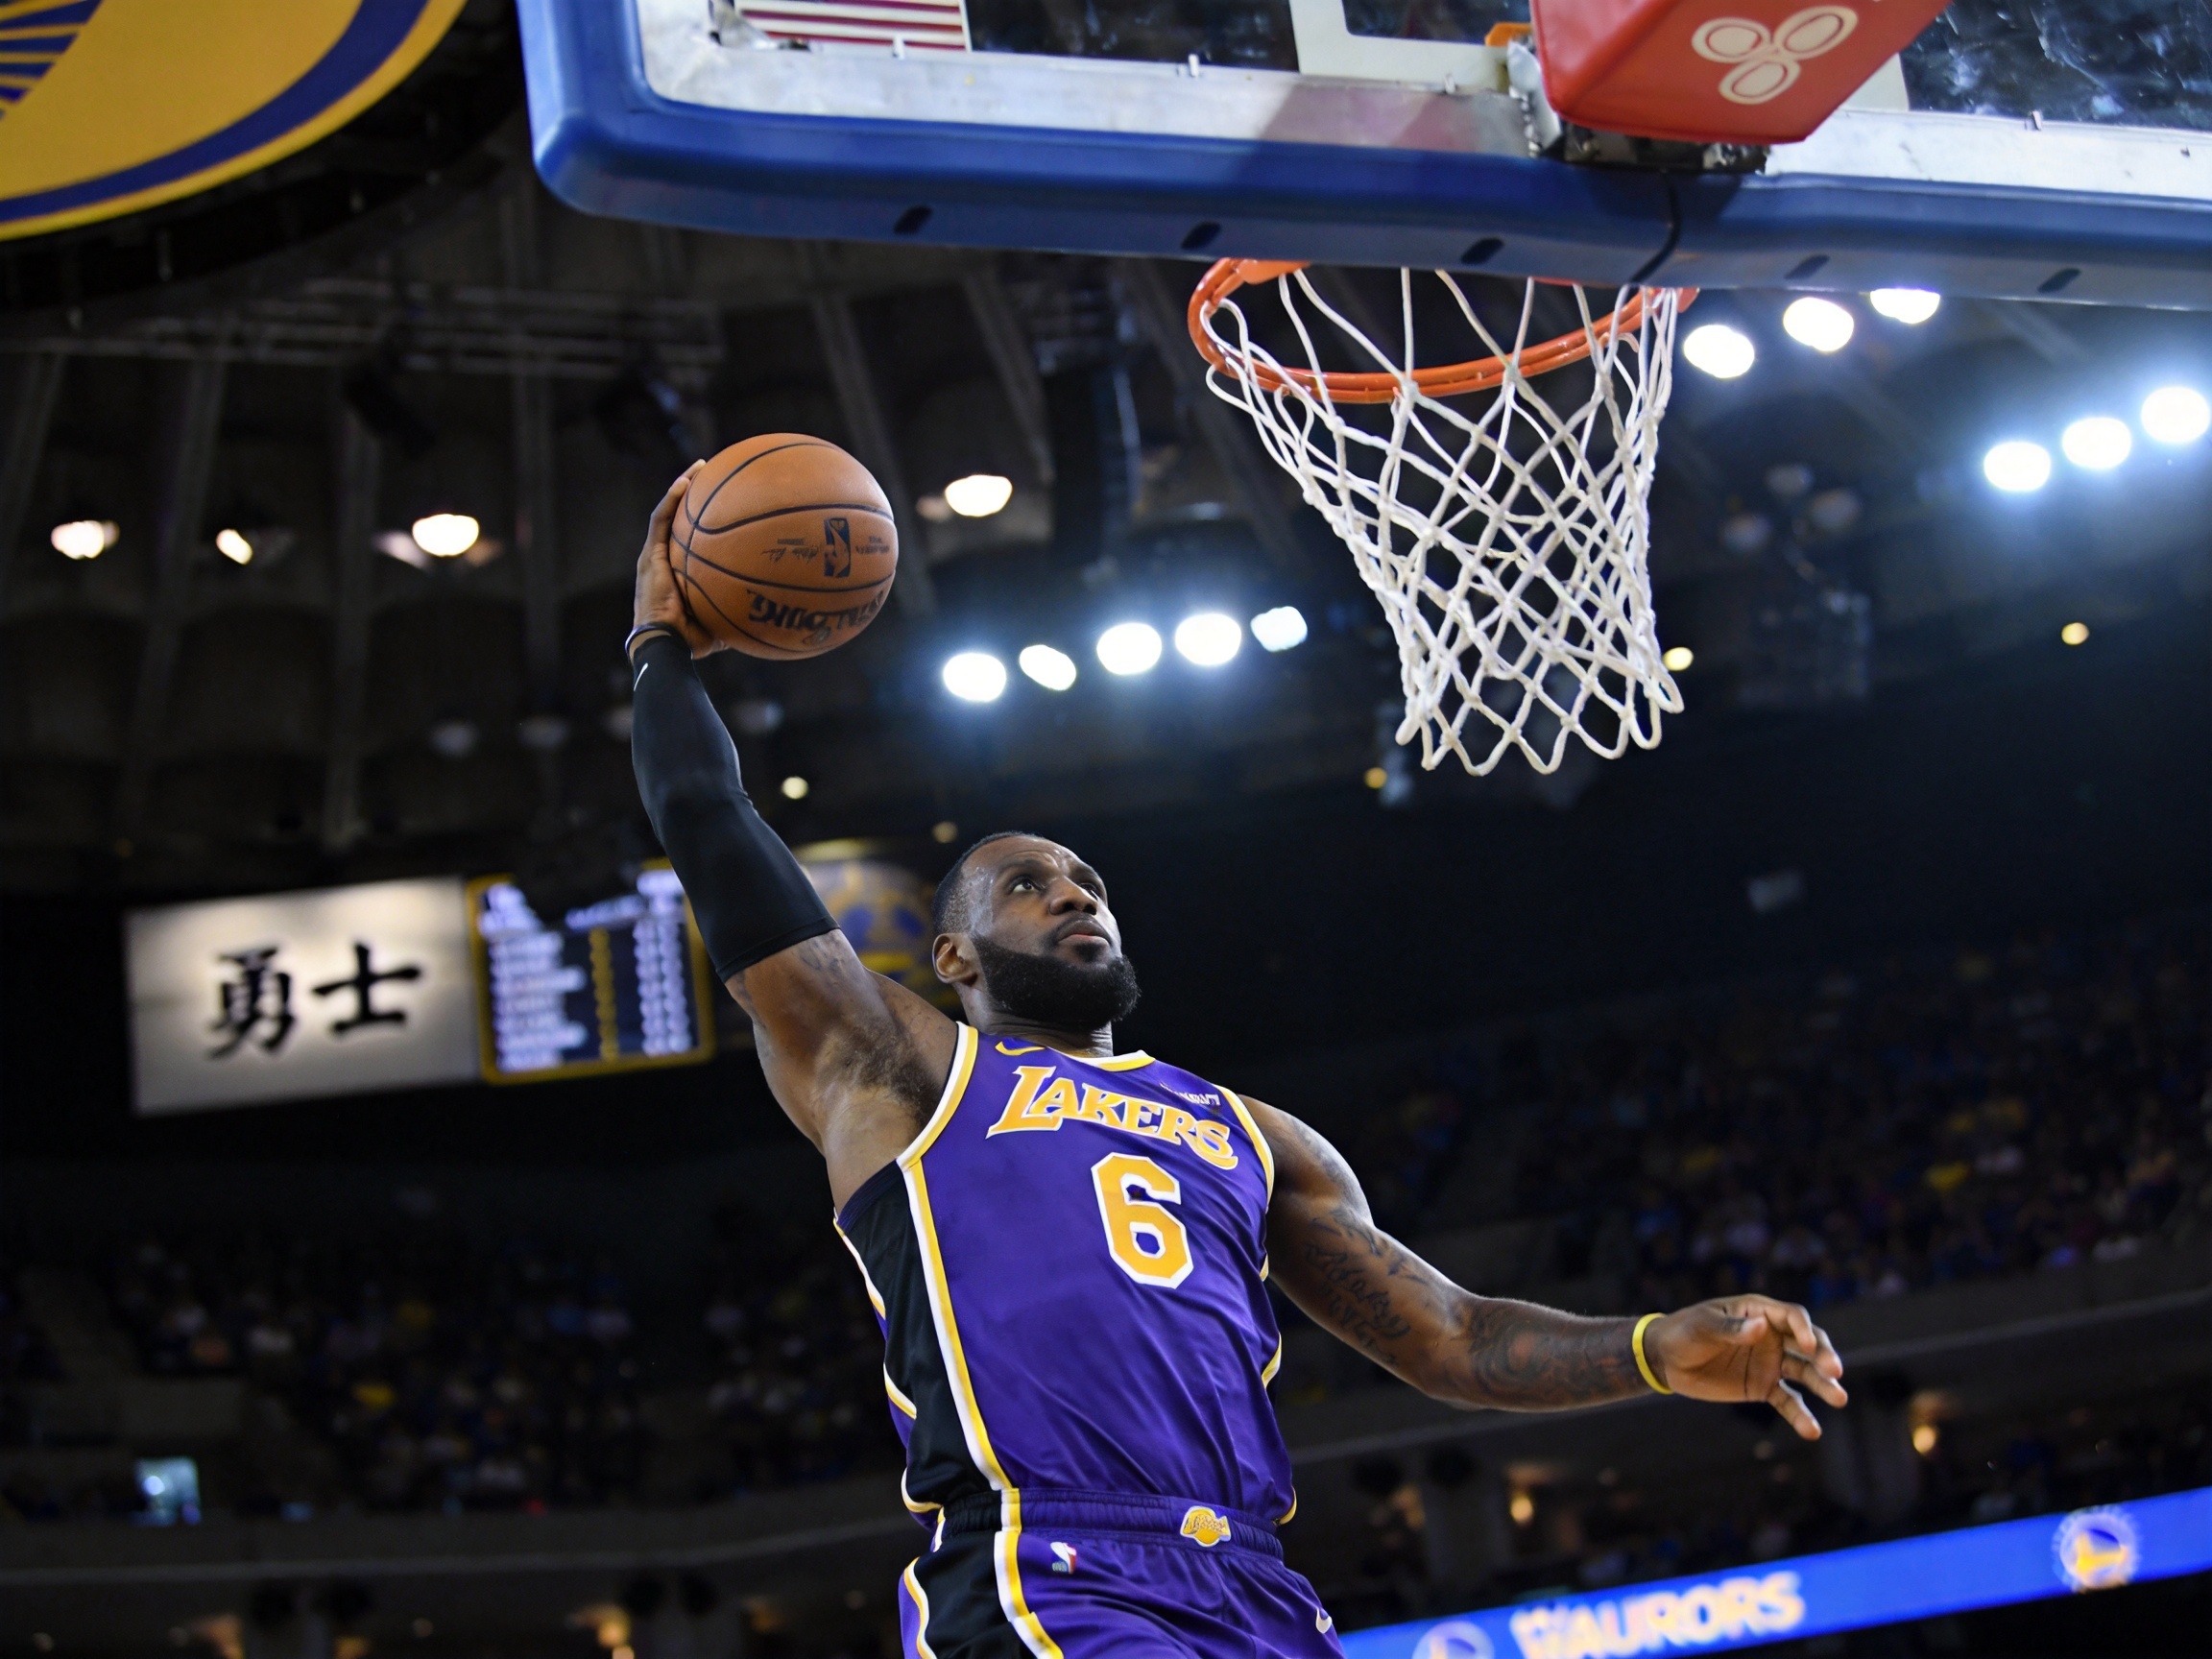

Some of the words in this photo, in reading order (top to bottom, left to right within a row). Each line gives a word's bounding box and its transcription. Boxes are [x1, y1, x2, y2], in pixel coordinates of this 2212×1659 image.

[205, 941, 421, 1059] 勇士
[985, 1066, 1238, 1170] LAKERS
[1091, 1152, 1194, 1289] 6
